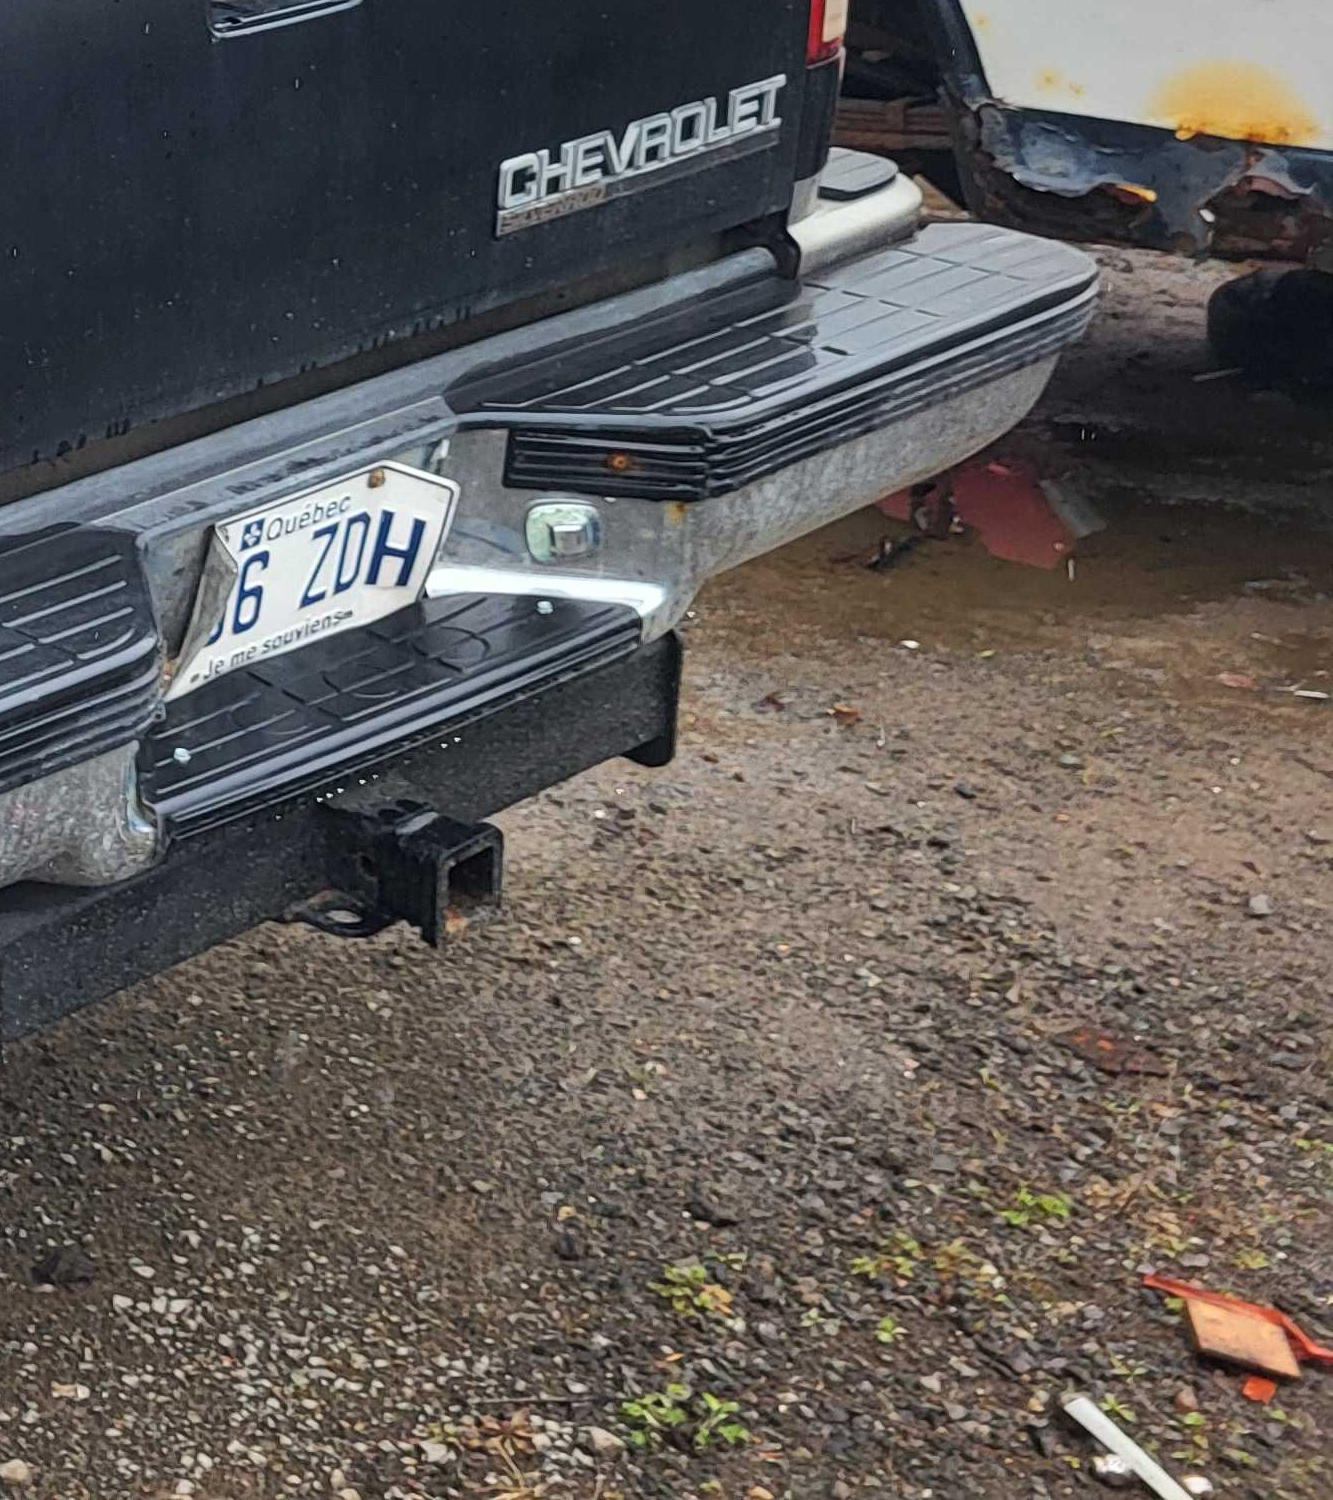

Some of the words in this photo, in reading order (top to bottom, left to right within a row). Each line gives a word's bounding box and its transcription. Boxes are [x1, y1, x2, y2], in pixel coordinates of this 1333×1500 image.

[497, 72, 787, 210] CHEVROLET
[266, 495, 352, 542] Québec
[297, 509, 428, 611] ZDH
[202, 659, 225, 680] Je
[229, 644, 257, 666] me
[259, 612, 345, 655] souviens
